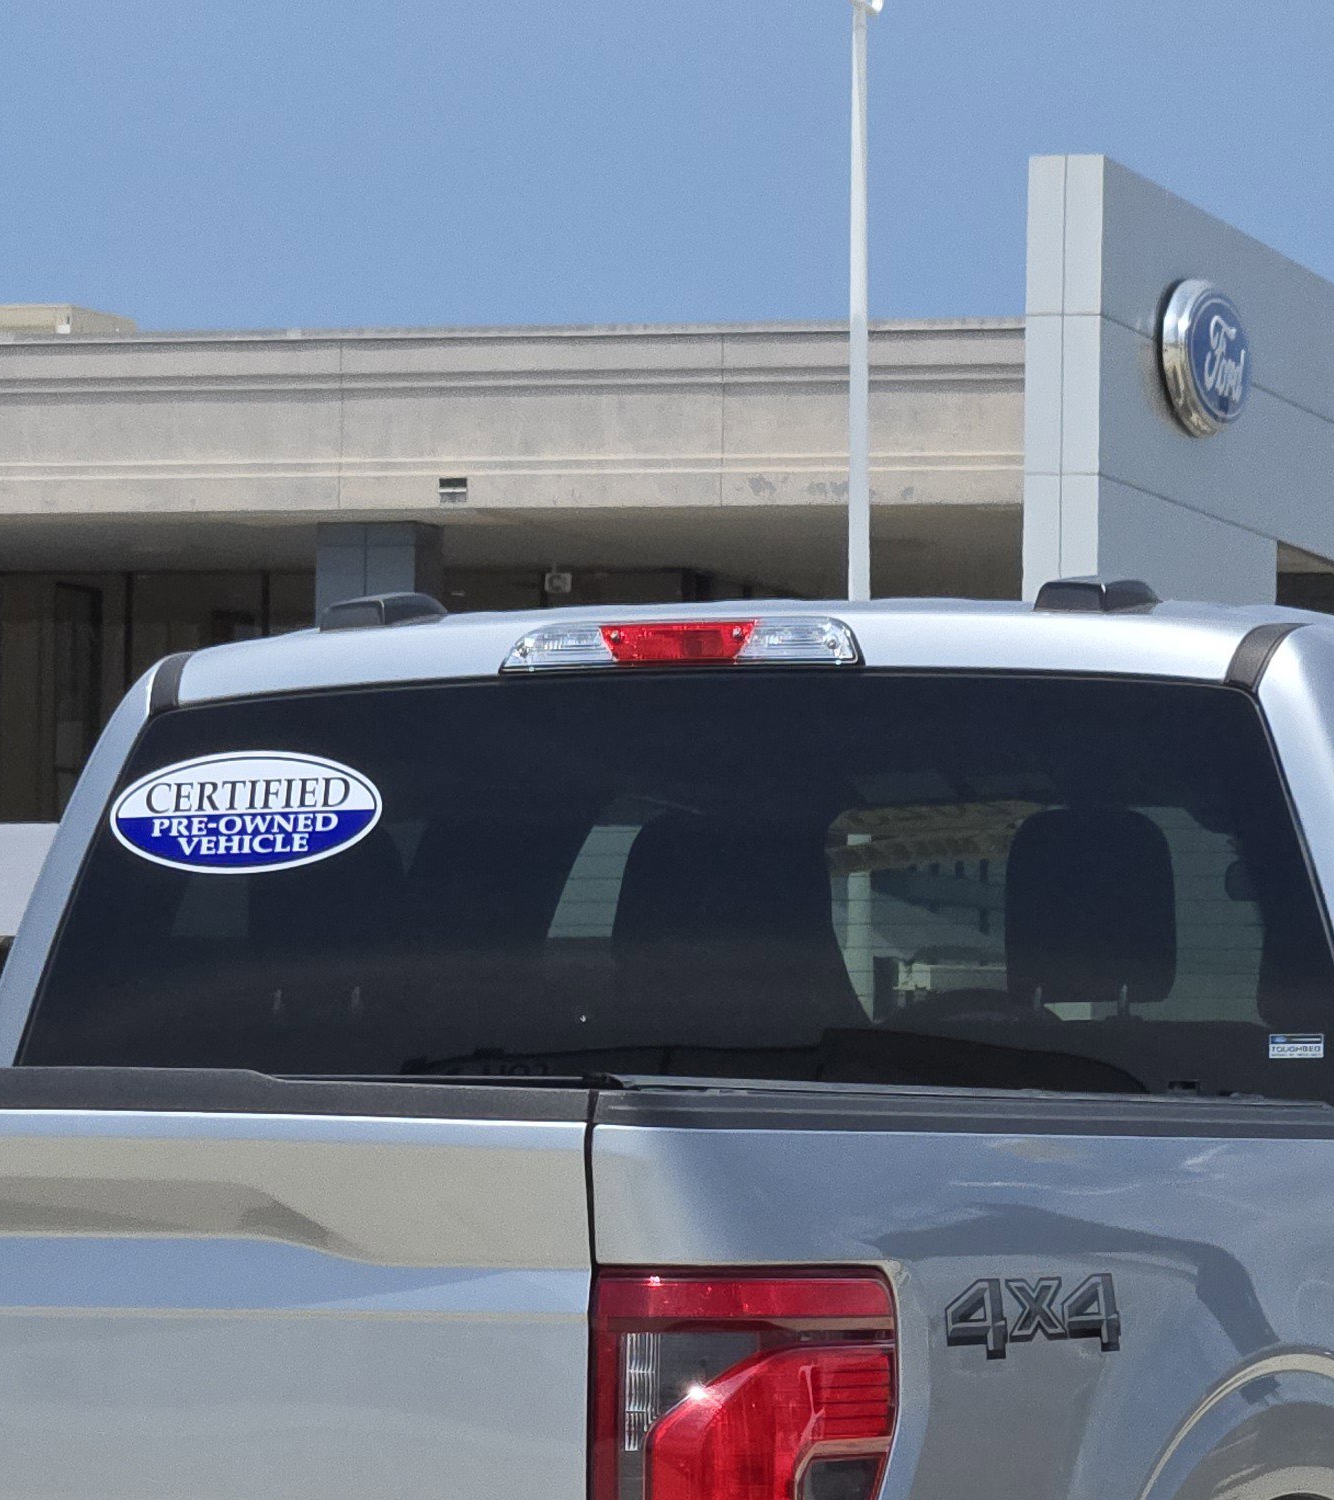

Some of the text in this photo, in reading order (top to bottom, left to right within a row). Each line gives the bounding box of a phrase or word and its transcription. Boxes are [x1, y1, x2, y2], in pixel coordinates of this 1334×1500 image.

[145, 776, 351, 814] CERTIFIED
[151, 813, 339, 837] PRE-OWNED
[177, 833, 309, 856] VEHICLE
